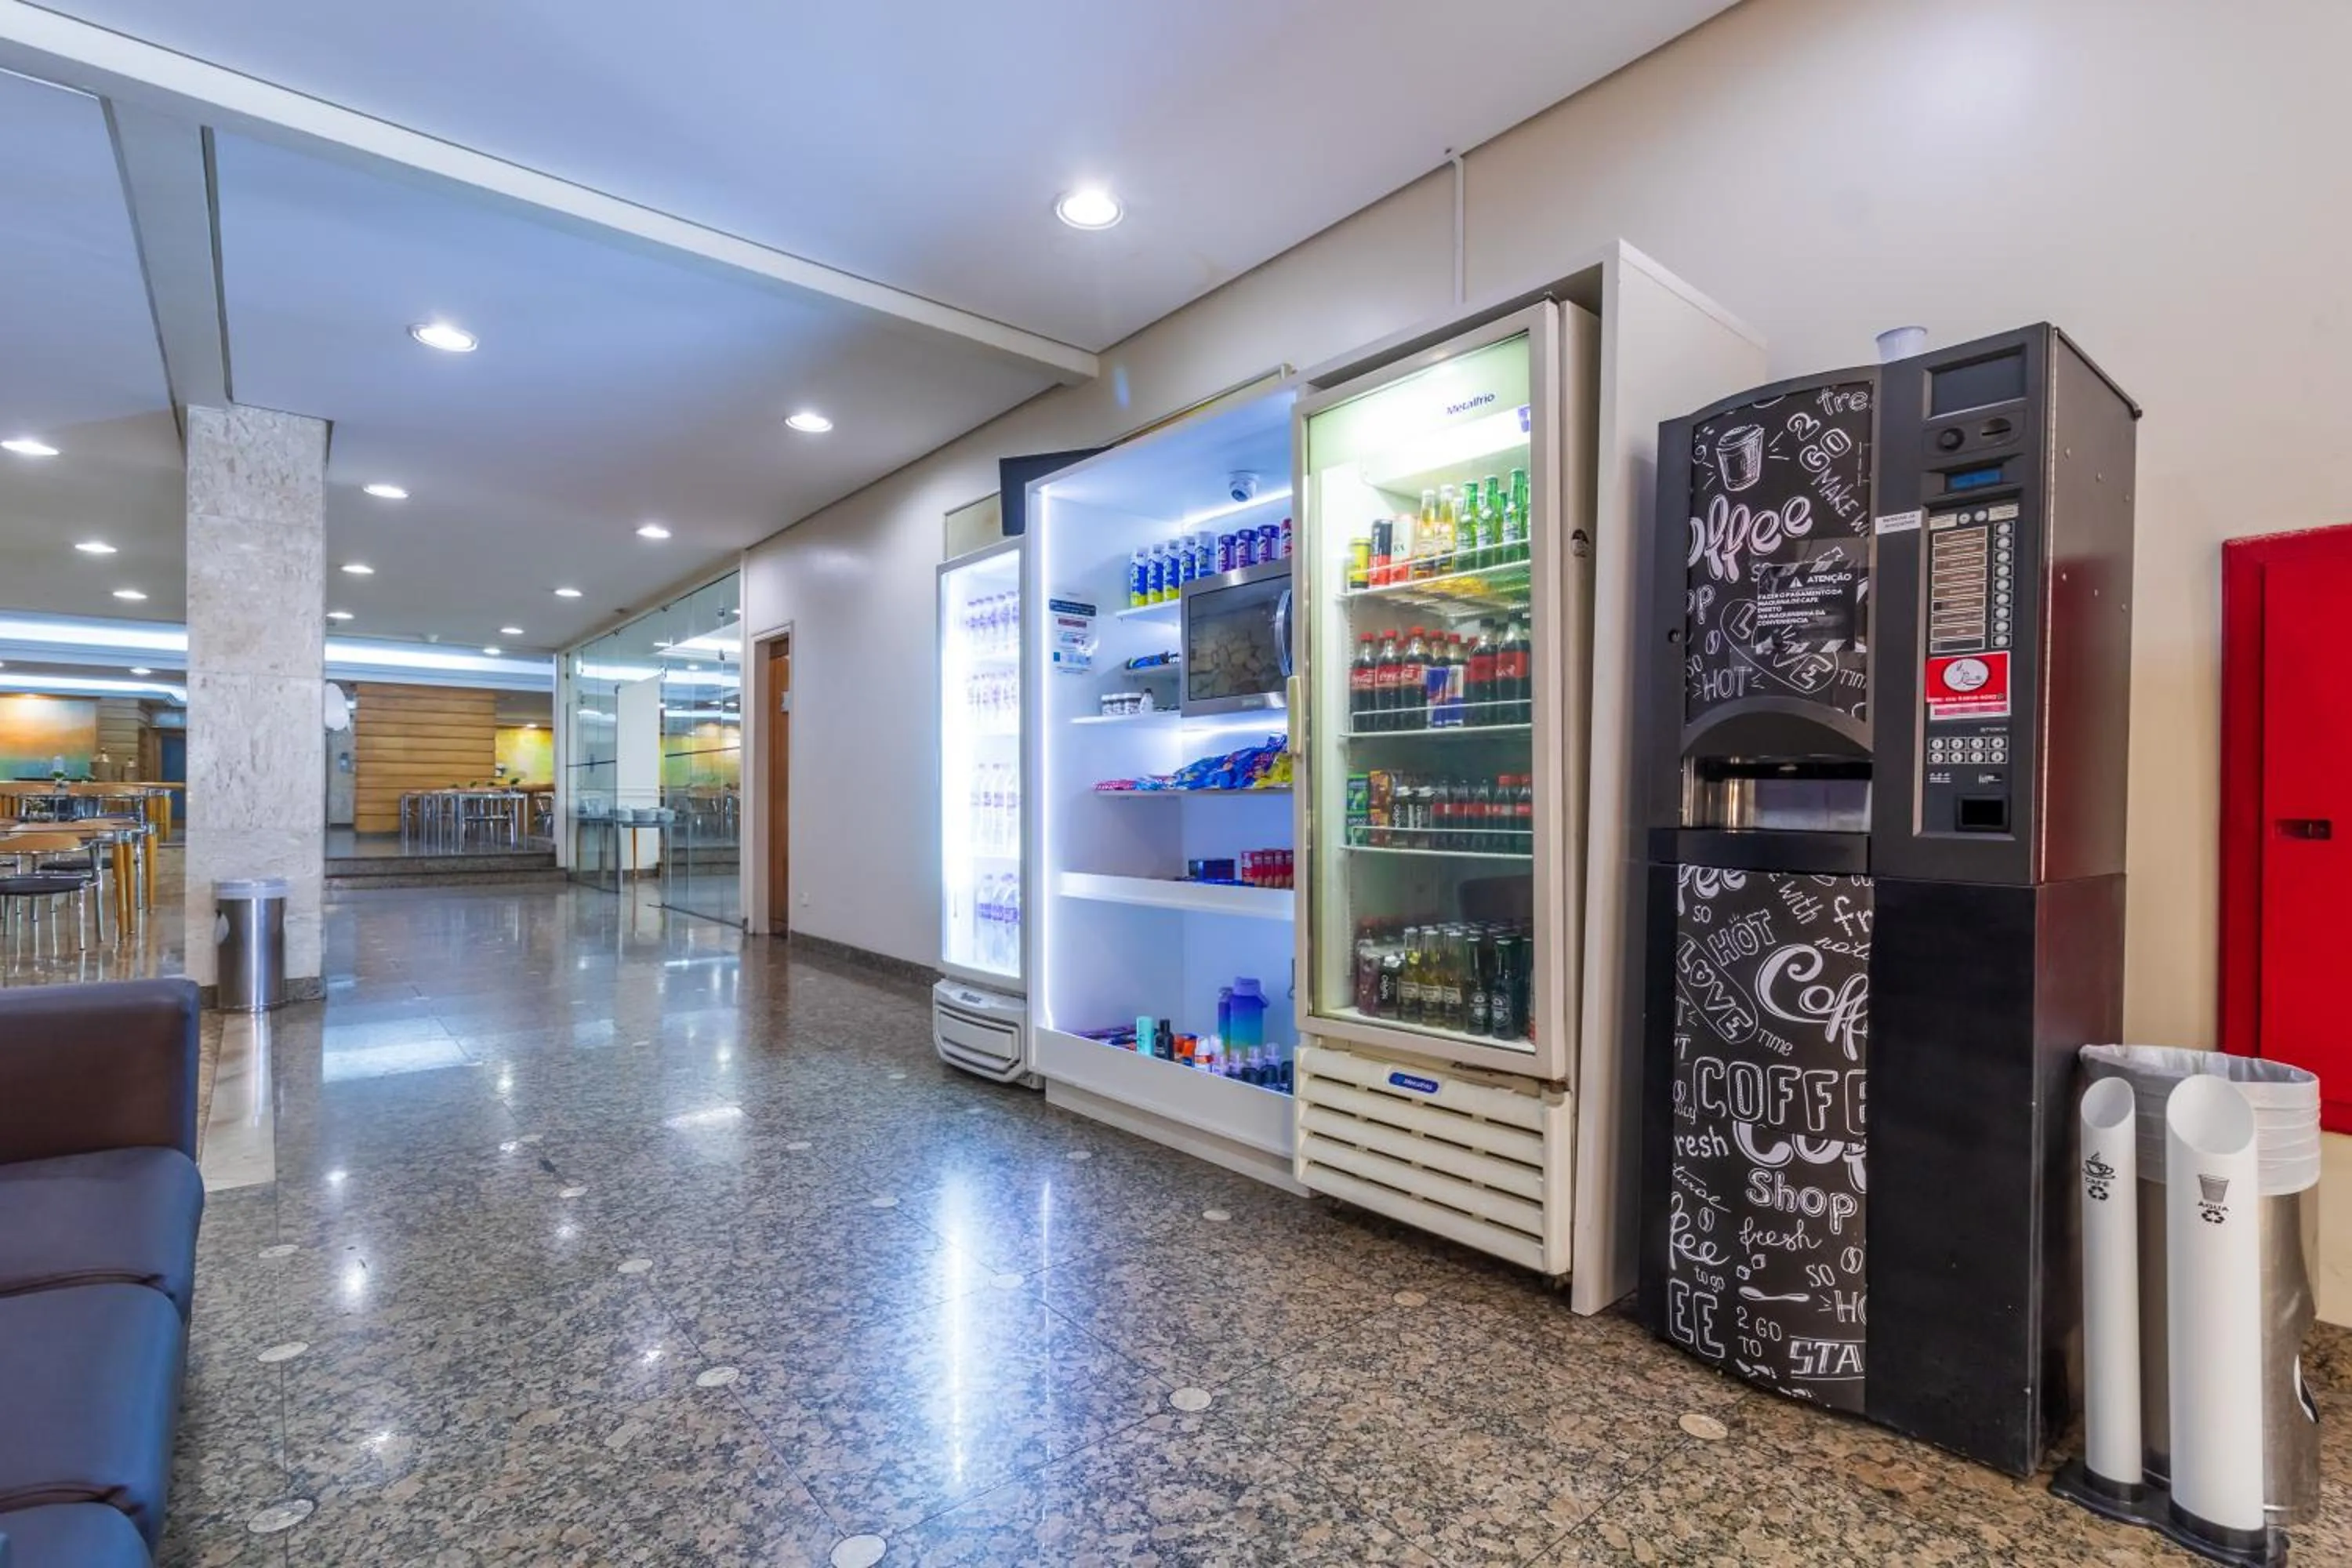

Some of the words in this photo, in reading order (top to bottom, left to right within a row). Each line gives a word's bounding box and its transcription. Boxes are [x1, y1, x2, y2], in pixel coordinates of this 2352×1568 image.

[1446, 393, 1496, 415] Metalfrio
[1787, 412, 1820, 441] 2
[1799, 428, 1852, 473] GO
[1810, 467, 1860, 517] MAKE
[1806, 573, 1853, 583] ATENÇÃO
[1702, 666, 1753, 701] HOT
[1693, 905, 1711, 924] SO
[1707, 908, 1776, 967] HOT
[1745, 1168, 1858, 1235] Shop
[1739, 1216, 1823, 1254] fresh
[1806, 1264, 1835, 1287] SO
[1737, 1305, 1749, 1330] 2
[1756, 1317, 1782, 1342] GO
[1737, 1335, 1762, 1357] TO
